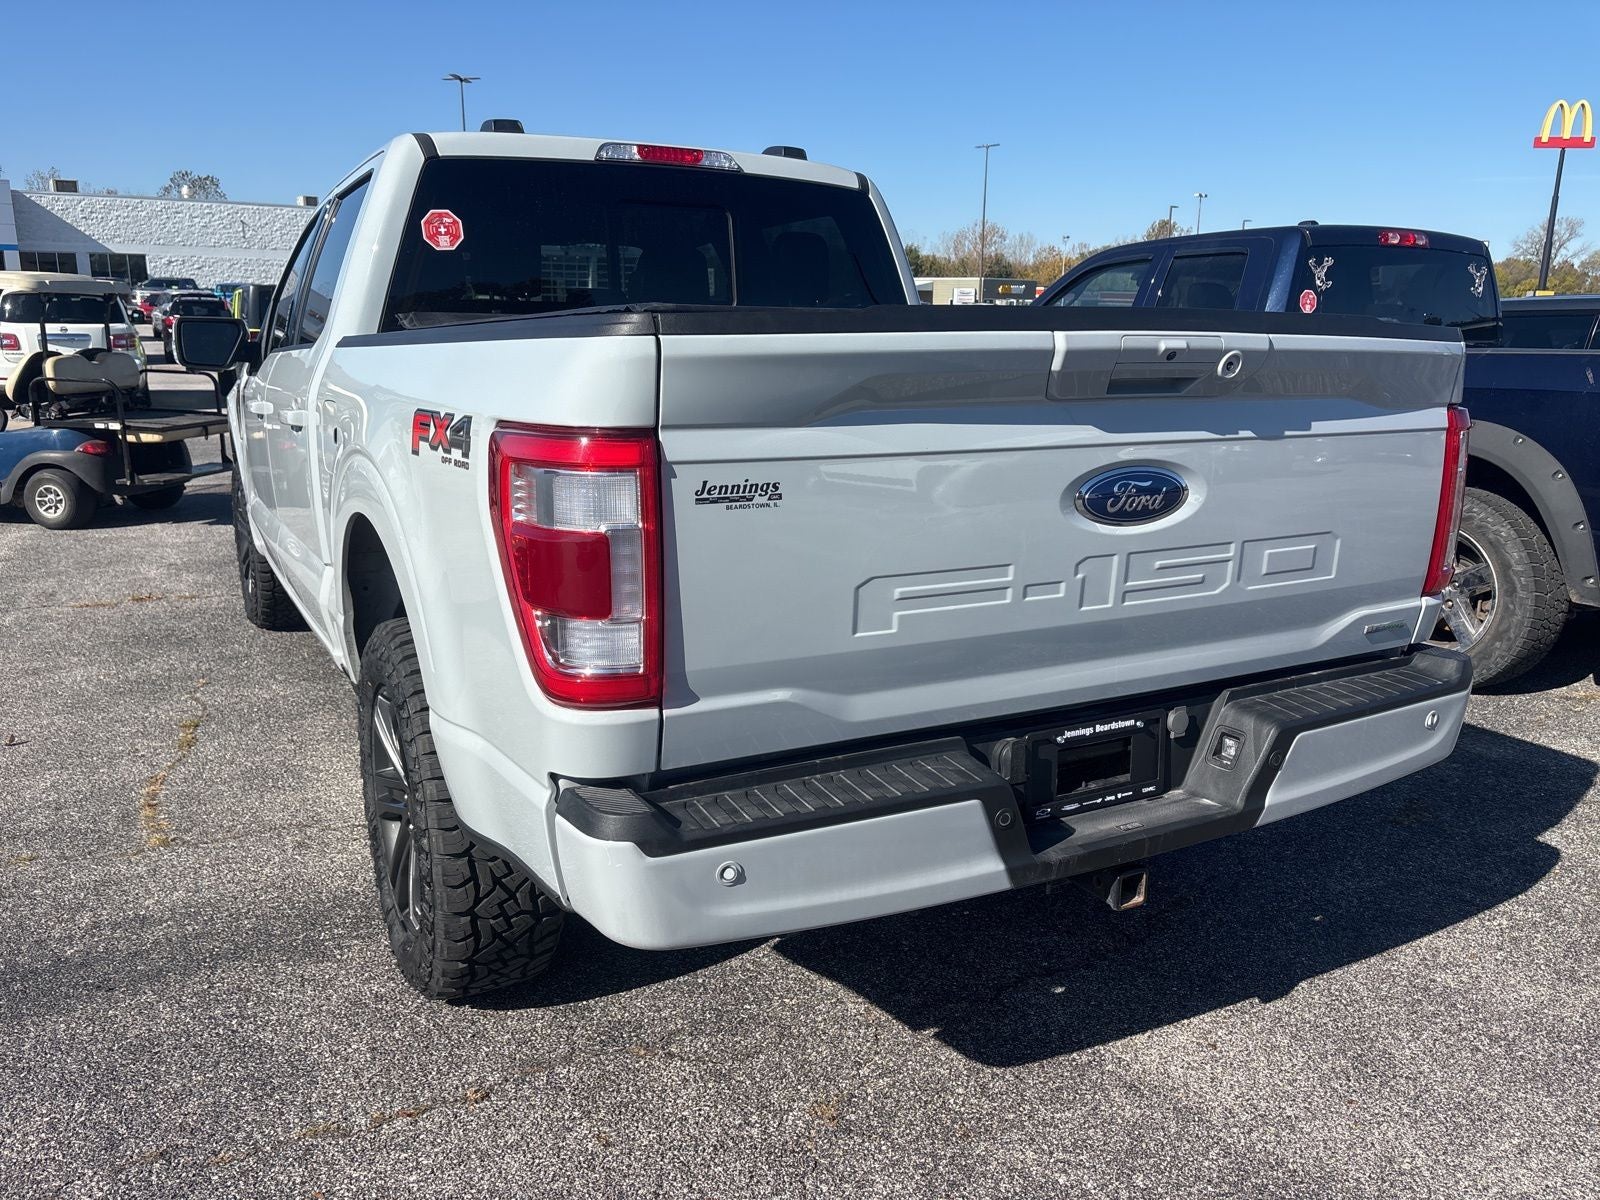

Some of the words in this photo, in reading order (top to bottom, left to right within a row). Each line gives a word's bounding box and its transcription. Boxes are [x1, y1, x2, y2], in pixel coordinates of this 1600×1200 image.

[411, 408, 473, 459] FX4
[441, 456, 452, 464] OFF
[454, 459, 469, 470] ROAD
[695, 479, 780, 496] Jennings
[1106, 480, 1167, 514] Ford
[852, 531, 1341, 637] F-150
[1063, 728, 1094, 738] Jennings
[1095, 719, 1135, 733] Beardstown
